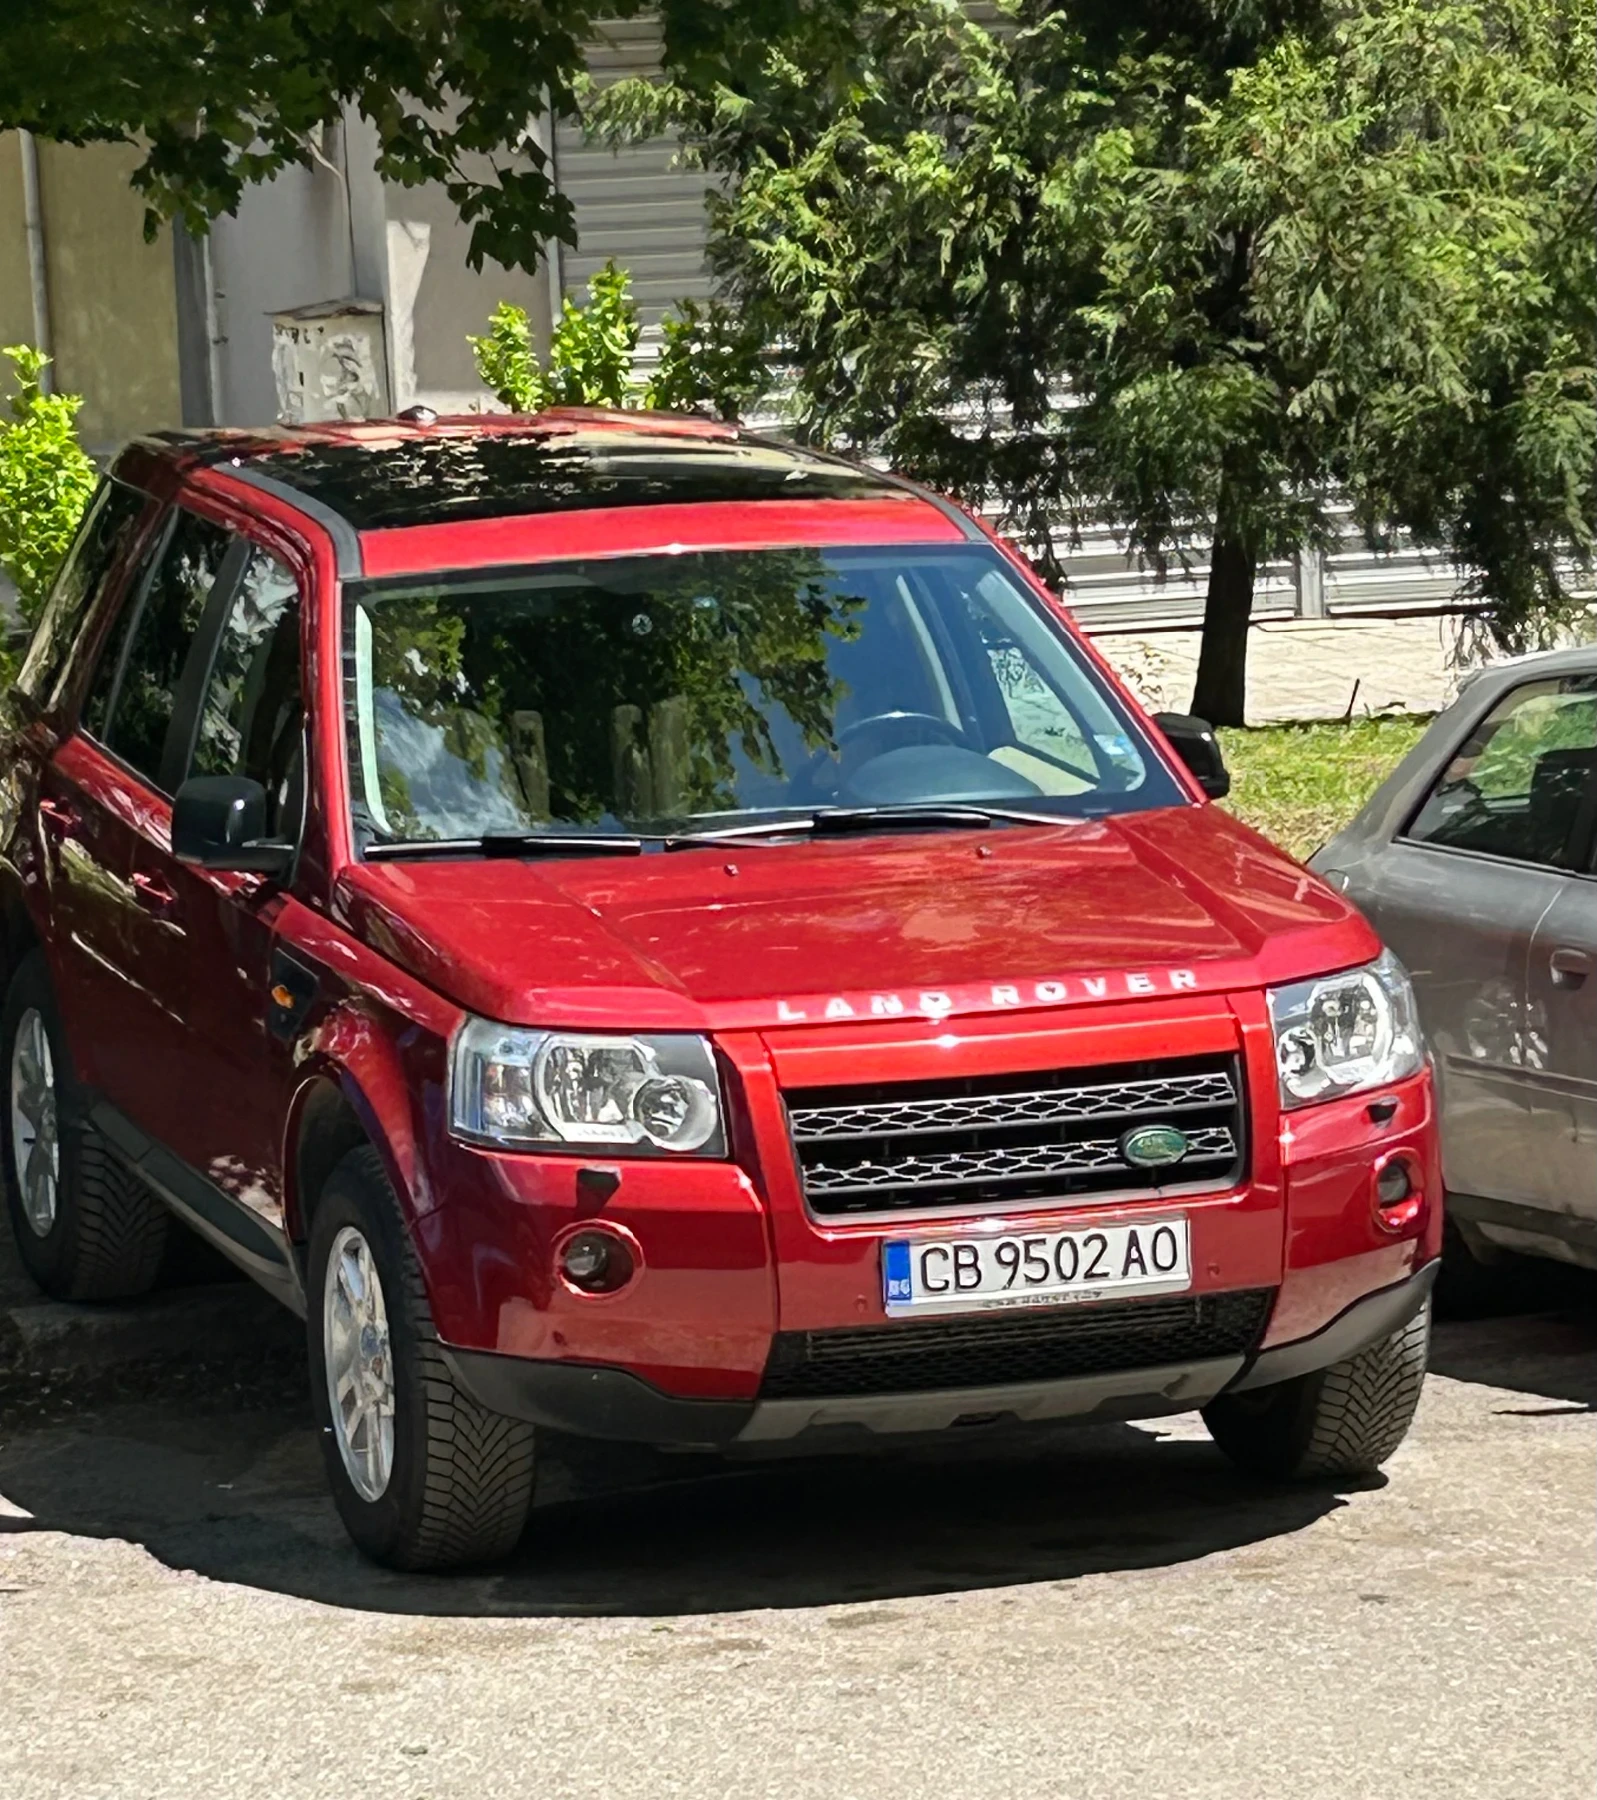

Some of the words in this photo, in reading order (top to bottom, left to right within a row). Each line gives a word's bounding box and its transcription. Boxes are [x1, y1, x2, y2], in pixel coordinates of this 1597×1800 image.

[777, 992, 952, 1021] LAND
[991, 969, 1197, 1006] ROVER
[920, 1244, 982, 1292] CB
[994, 1234, 1110, 1290] 9502
[1121, 1226, 1177, 1277] AO
